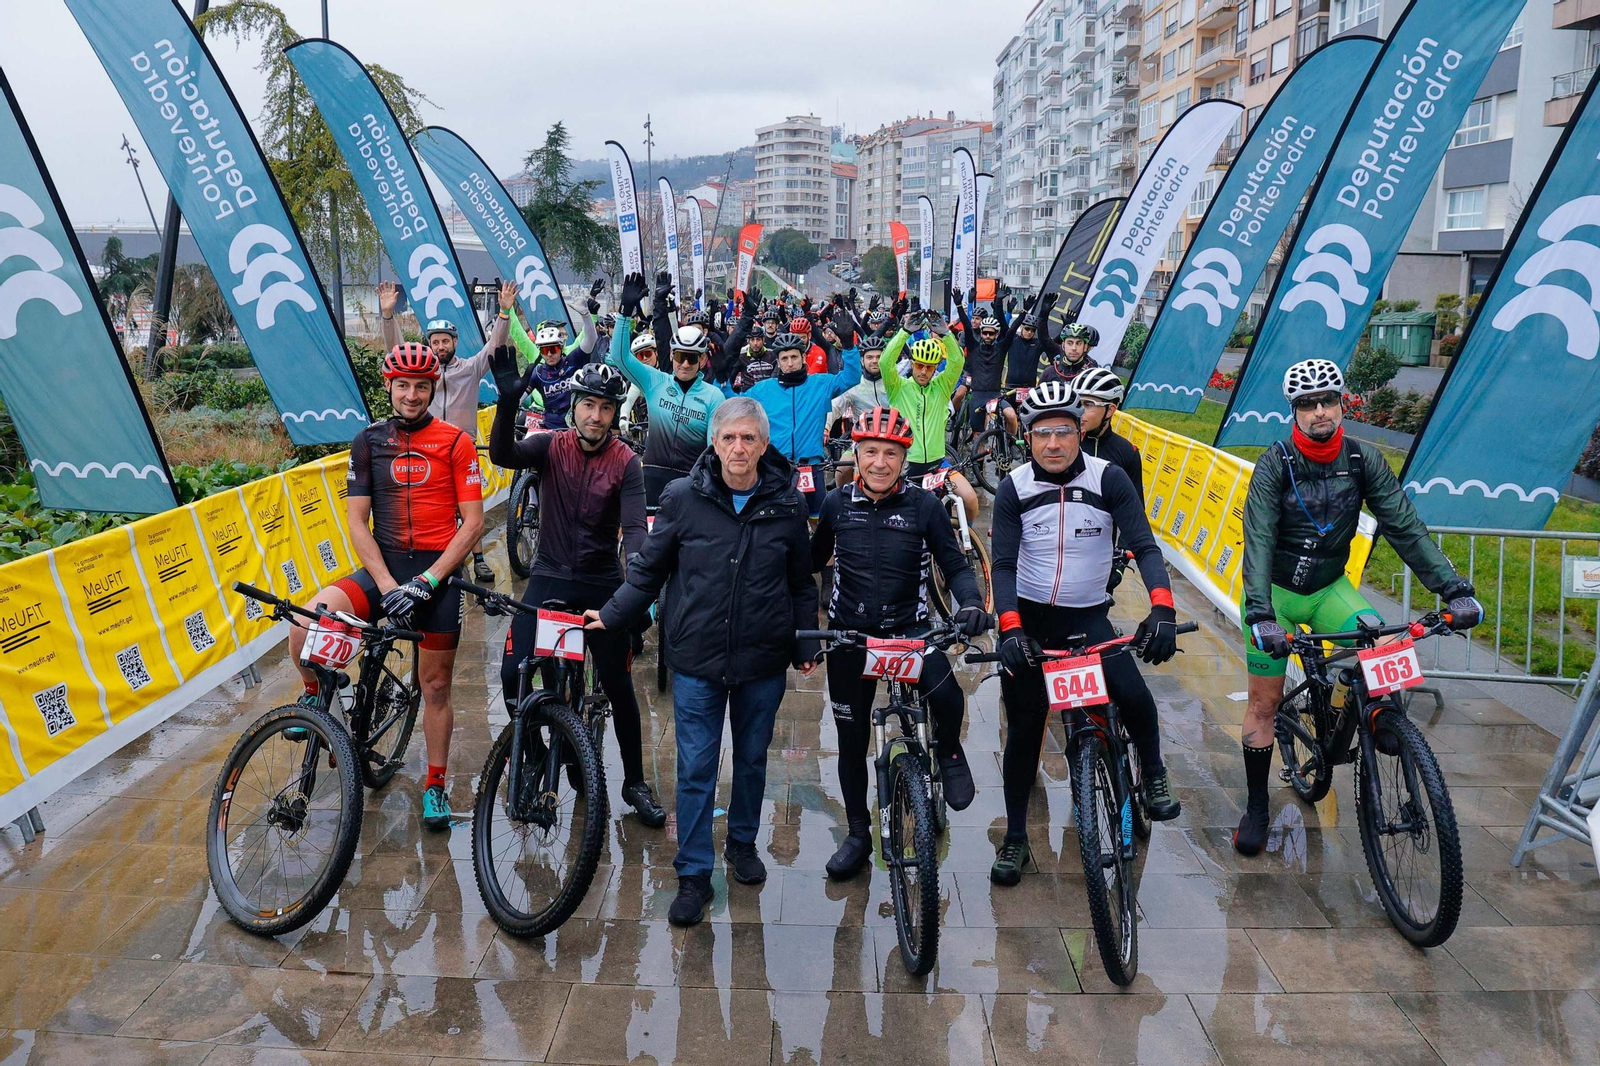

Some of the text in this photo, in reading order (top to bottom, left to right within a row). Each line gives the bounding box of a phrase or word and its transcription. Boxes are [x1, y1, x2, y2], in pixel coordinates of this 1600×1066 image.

[1337, 37, 1439, 208] Deputación
[1362, 49, 1463, 220] Pontevedra
[1218, 114, 1298, 237] Deputación
[1237, 124, 1316, 246] Pontevedra
[1121, 156, 1177, 249] Deputación
[1135, 165, 1190, 256] Pontevedra
[212, 522, 239, 543] MeUFIT
[154, 543, 188, 569] MeUFIT
[82, 570, 123, 599] MeUFIT
[0, 602, 45, 635] MeUFIT
[318, 634, 353, 662] 270
[557, 628, 566, 650] 1
[17, 651, 56, 675] www.meufit.gal
[872, 656, 916, 677] 497
[1370, 656, 1413, 686] 163
[1053, 672, 1099, 701] 644
